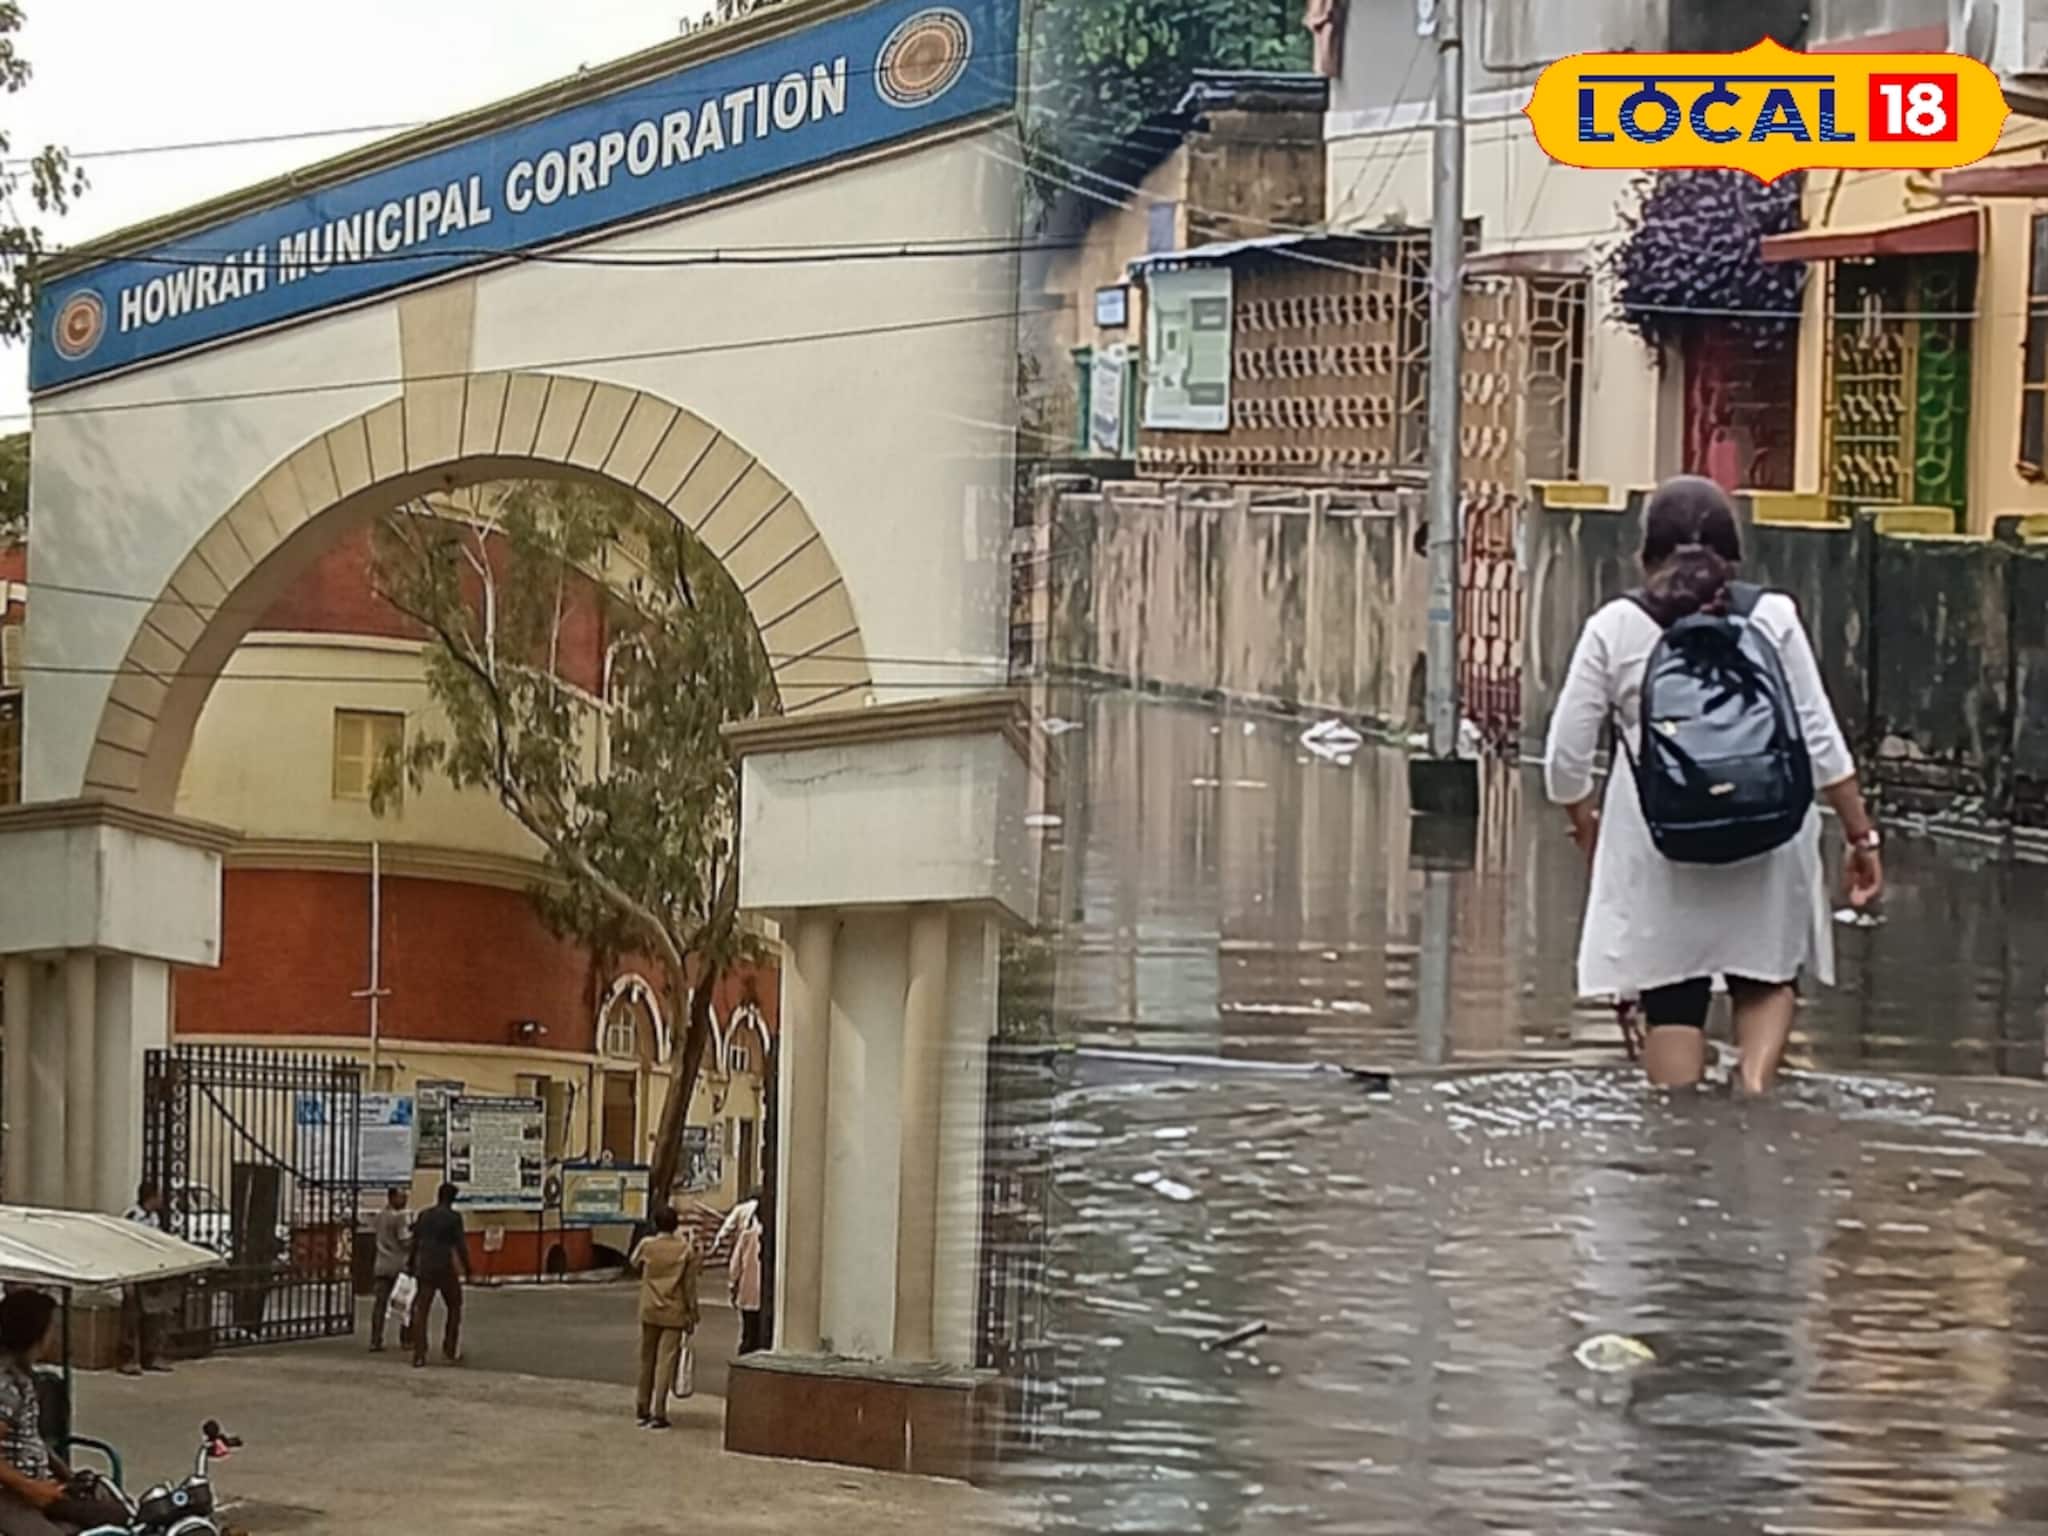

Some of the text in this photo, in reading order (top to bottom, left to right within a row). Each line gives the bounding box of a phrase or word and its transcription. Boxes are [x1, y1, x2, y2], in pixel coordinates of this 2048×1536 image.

[119, 244, 267, 333] HOWRAH
[278, 174, 492, 286] MUNICIPAL
[505, 56, 847, 213] CORPORATION
